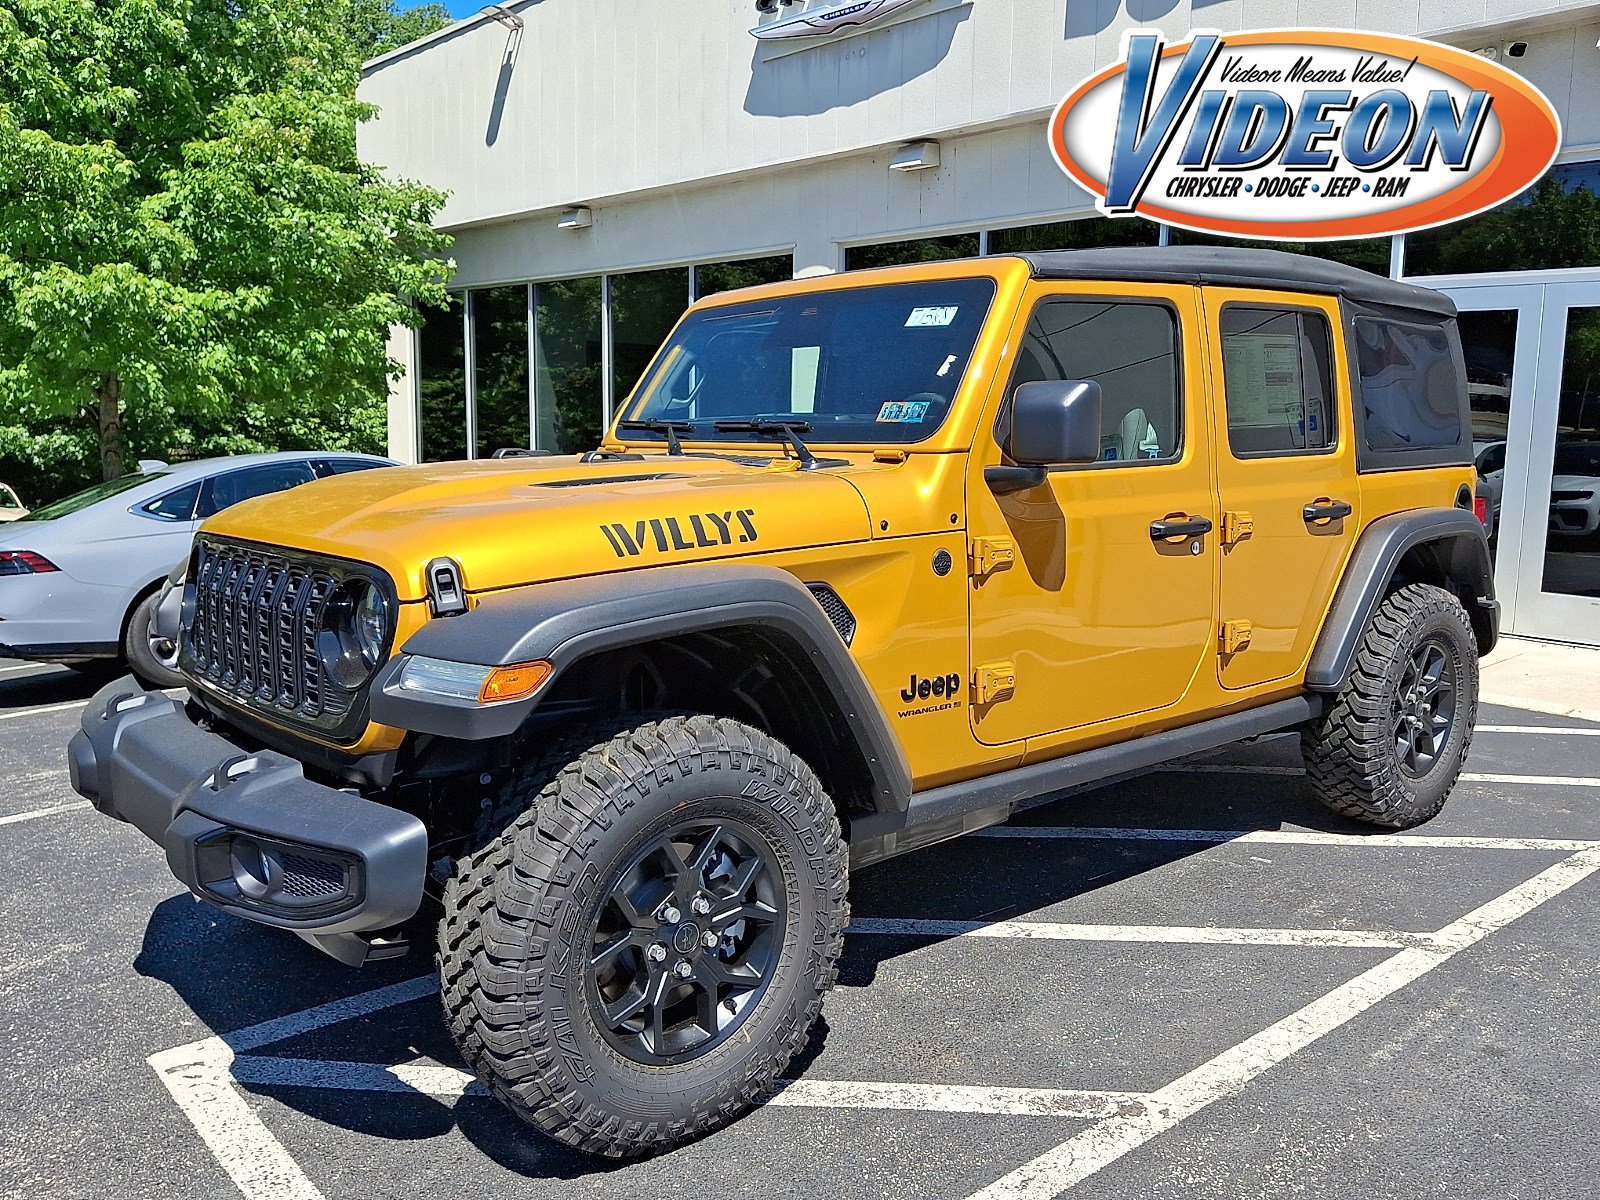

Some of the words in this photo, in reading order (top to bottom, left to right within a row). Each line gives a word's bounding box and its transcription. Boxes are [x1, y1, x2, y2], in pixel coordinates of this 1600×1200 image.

[823, 4, 865, 20] CHRYSLER
[599, 508, 758, 558] WILLYS
[900, 673, 960, 703] Jeep
[898, 703, 952, 719] WRANGLER
[740, 778, 829, 978] WILDPEAK
